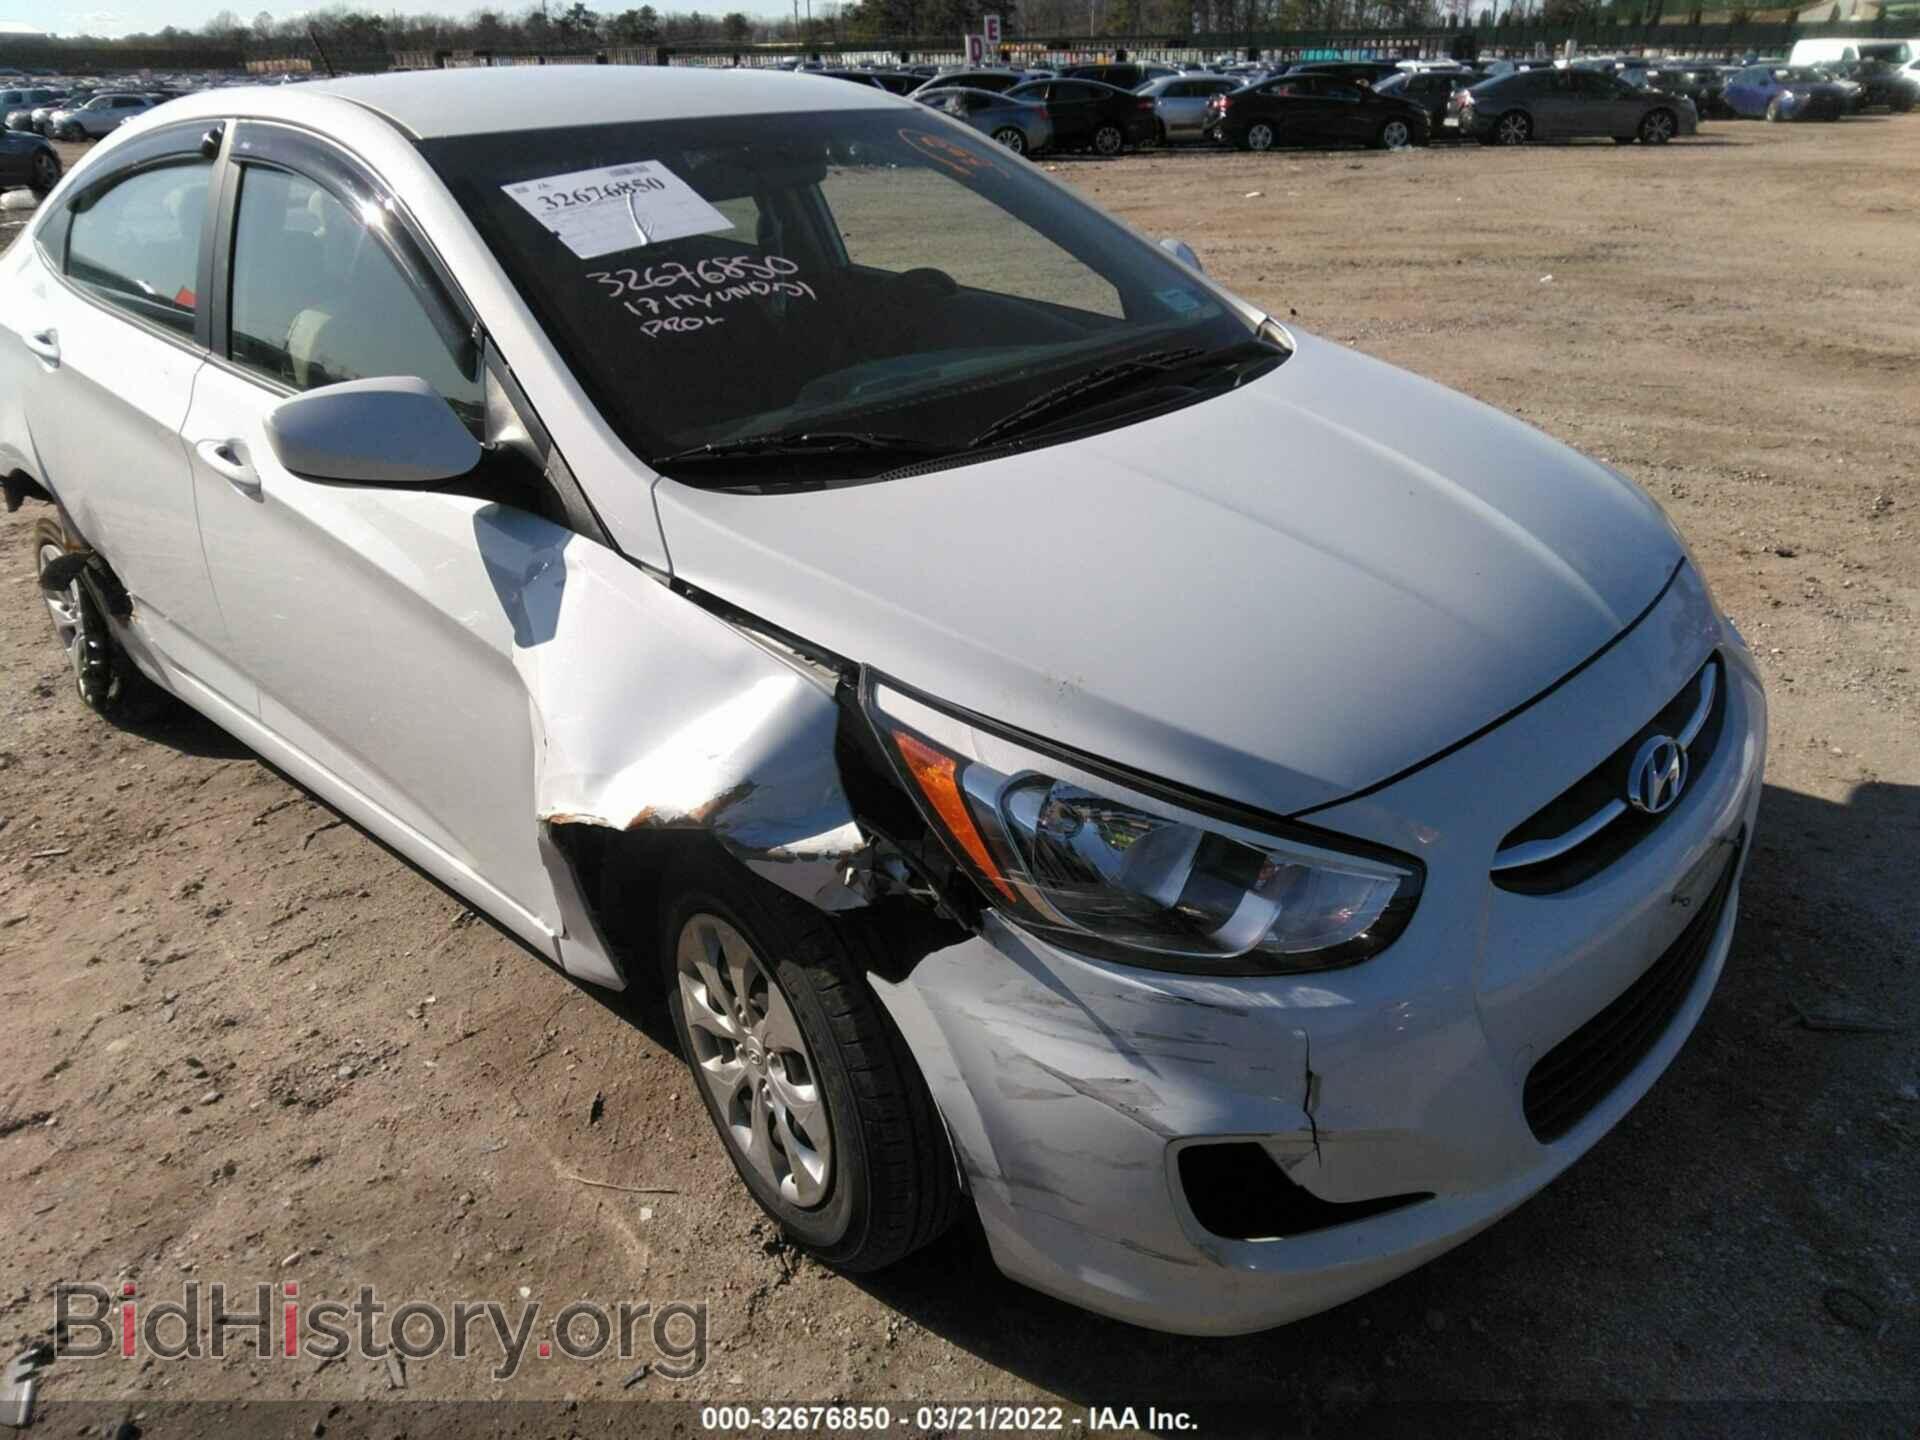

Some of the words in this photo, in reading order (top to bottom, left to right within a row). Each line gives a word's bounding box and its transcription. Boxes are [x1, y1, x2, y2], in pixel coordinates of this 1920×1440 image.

[537, 176, 666, 211] 32676850
[586, 255, 800, 297] 32676850
[623, 297, 660, 317] 17
